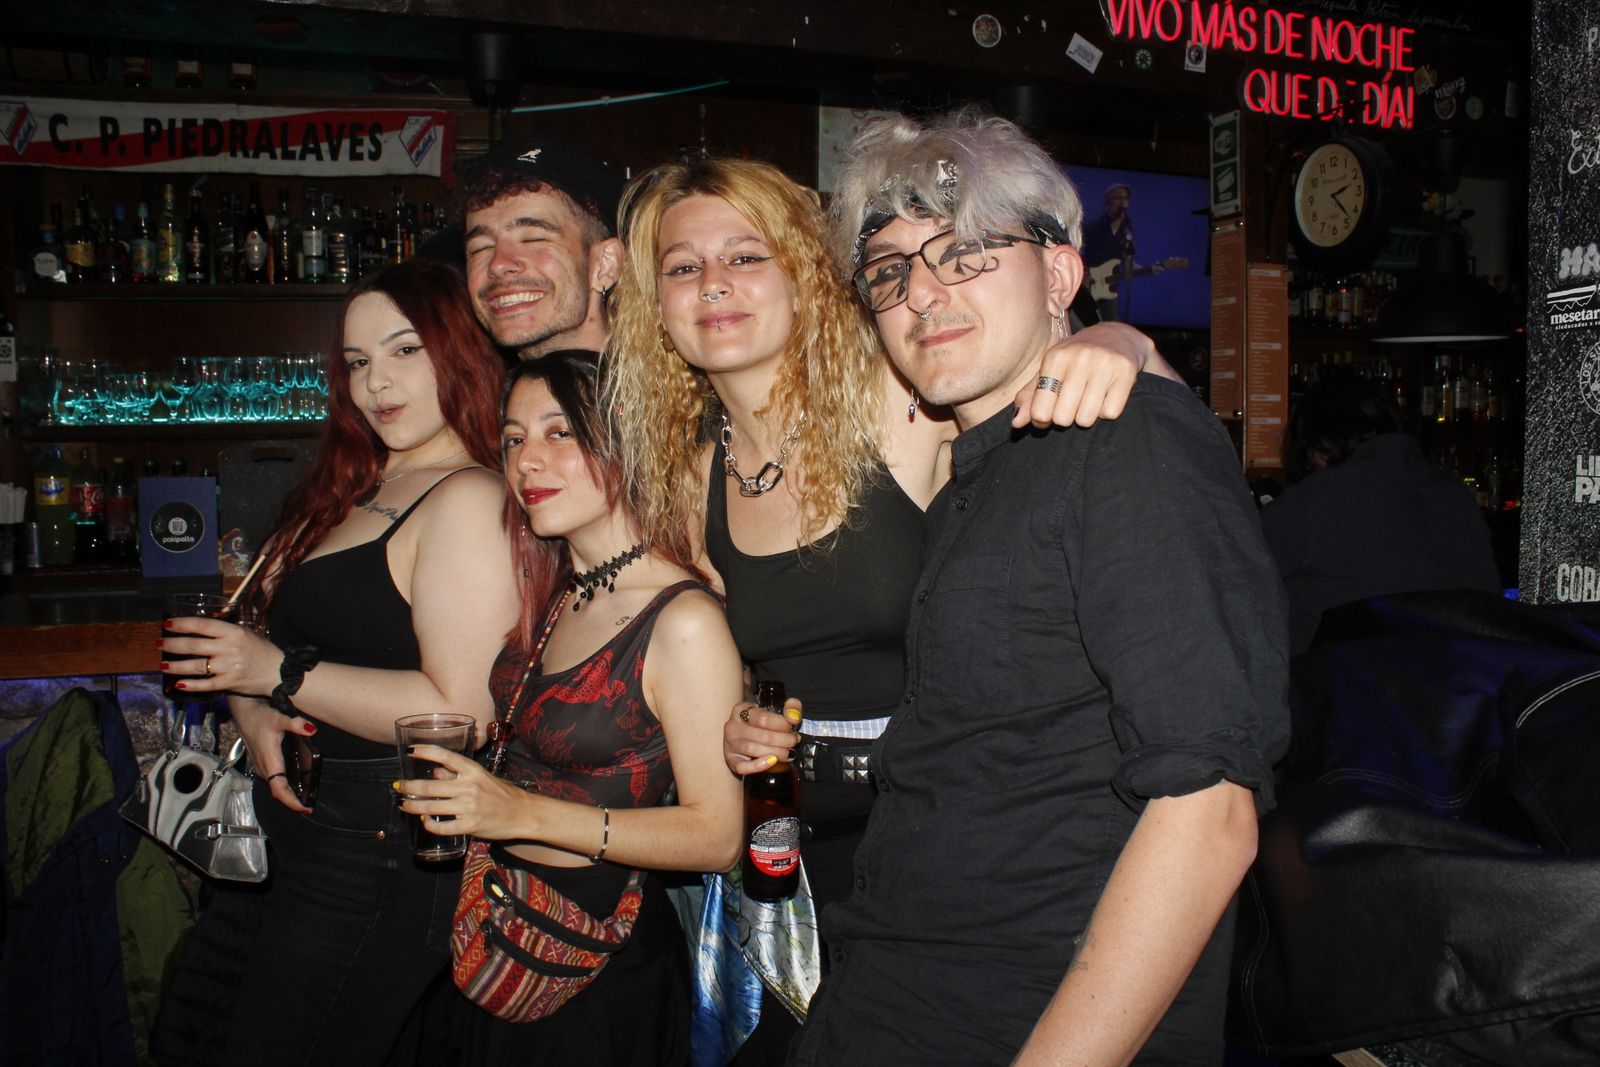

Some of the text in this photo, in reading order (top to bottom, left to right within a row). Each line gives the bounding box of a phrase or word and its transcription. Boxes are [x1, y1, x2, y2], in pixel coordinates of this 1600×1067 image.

[1107, 0, 1415, 71] VIVO MÁS DE NOCHE
[1587, 27, 1600, 52] P
[1244, 68, 1312, 119] QUE
[1317, 77, 1357, 124] D
[1363, 72, 1414, 129] DÍA!
[48, 113, 83, 154] C.
[100, 116, 126, 157] P.
[143, 117, 384, 162] PIEDRALAVES
[1556, 563, 1600, 603] COB
